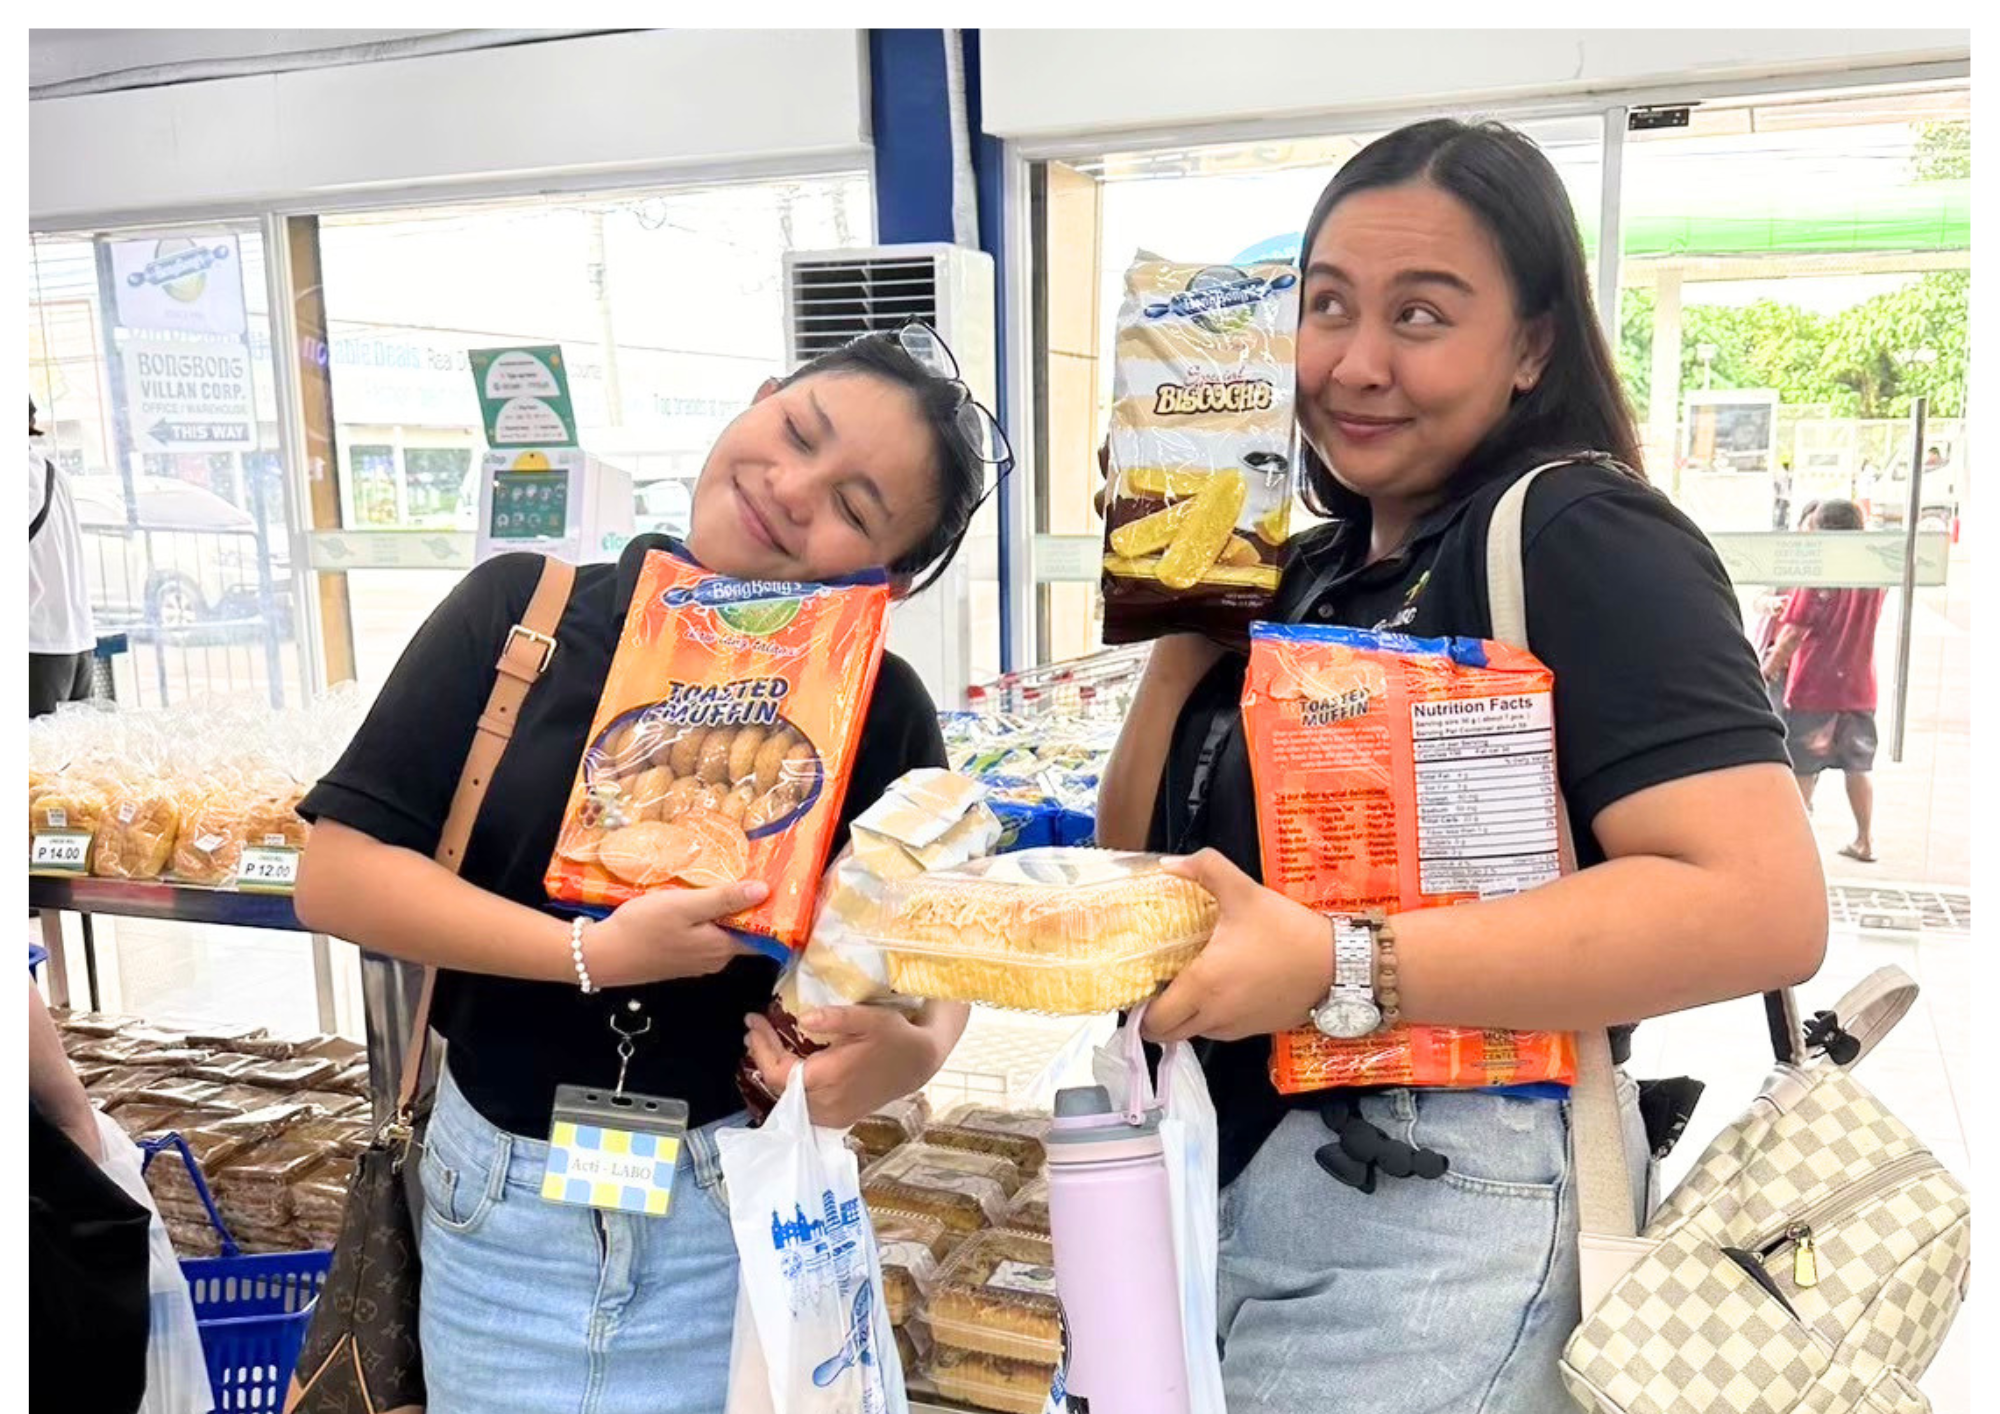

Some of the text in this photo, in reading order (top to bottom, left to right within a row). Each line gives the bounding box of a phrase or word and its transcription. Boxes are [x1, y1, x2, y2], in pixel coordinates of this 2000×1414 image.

[140, 380, 247, 400] VILLAN CORP.
[1156, 381, 1274, 415] BISCOCHO
[141, 402, 179, 414] OFFICE
[171, 425, 245, 440] THIS WAY
[667, 676, 789, 704] TOASTED
[1299, 687, 1371, 713] TOASTED
[661, 700, 778, 726] MUFFIN
[1302, 701, 1368, 727] MUFFIN
[1413, 697, 1533, 718] Nutrition Facts
[1415, 719, 1443, 729] Serving
[1415, 728, 1443, 738] Serving
[38, 846, 80, 860] P 14.00
[245, 862, 291, 878] P 12.00
[571, 1157, 600, 1174] Acti
[611, 1163, 652, 1180] LABO
